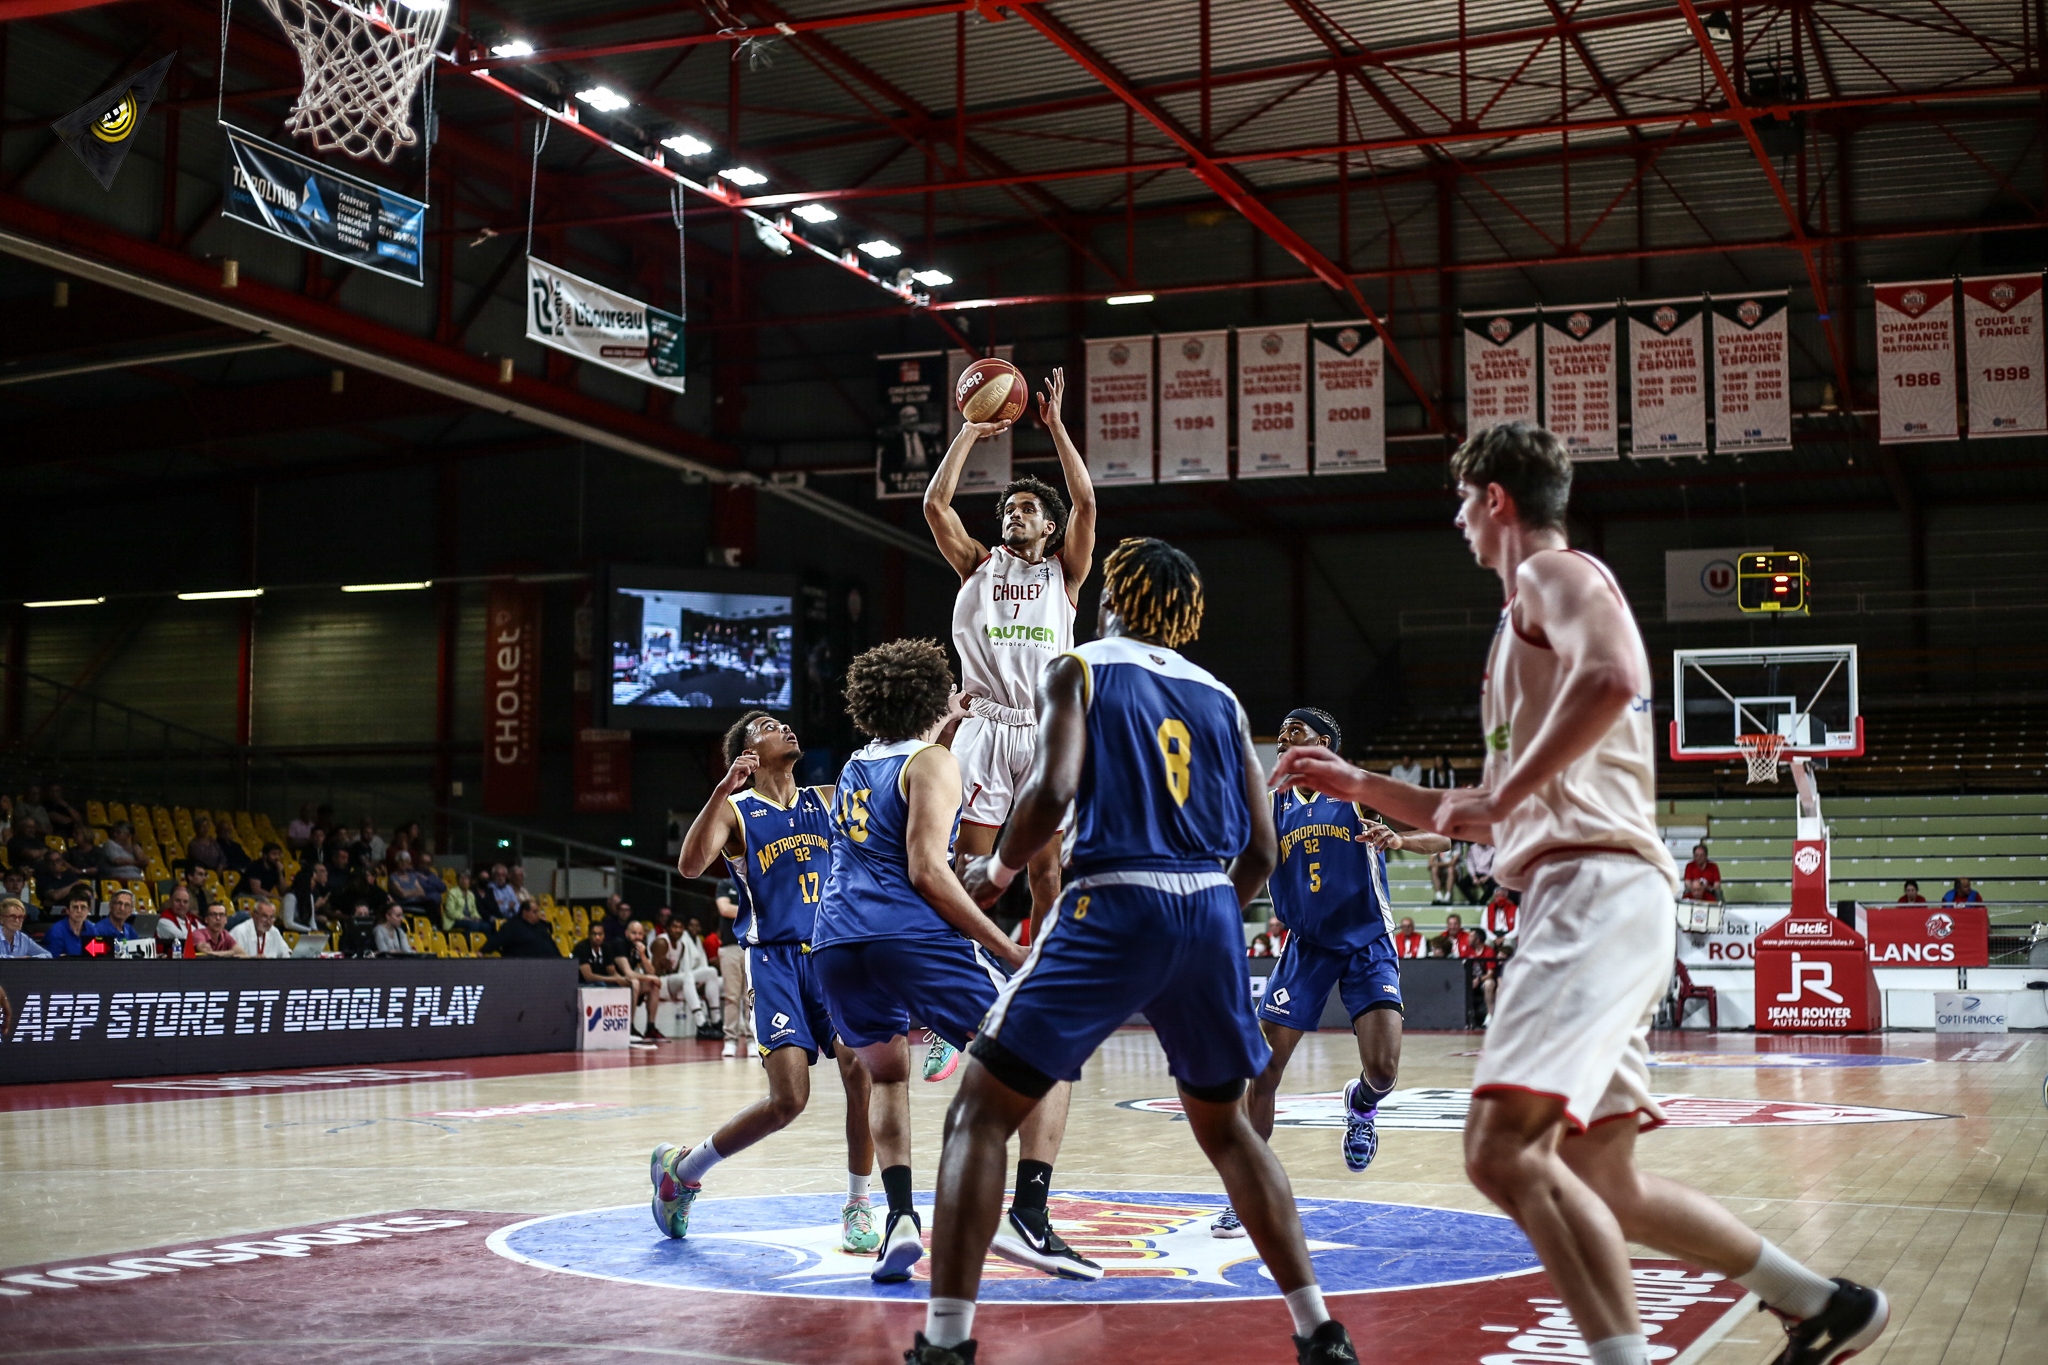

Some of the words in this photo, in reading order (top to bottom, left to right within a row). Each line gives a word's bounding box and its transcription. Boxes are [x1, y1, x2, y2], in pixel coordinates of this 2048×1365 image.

[1882, 321, 1948, 333] CHAMPION
[1975, 316, 2015, 327] COUPE
[2020, 316, 2033, 324] DE
[1718, 332, 1782, 344] CHAMPION
[1898, 332, 1949, 343] FRANCE
[1979, 326, 2030, 338] FRANCE
[1482, 348, 1519, 359] COUPE
[1548, 343, 1611, 354] CHAMPION
[1655, 348, 1694, 358] FUTUR
[1734, 342, 1782, 353] FRANCE
[1882, 344, 1939, 354] NATIONALE
[1485, 358, 1531, 369] FRANCE
[1564, 353, 1611, 363] FRANCE
[1638, 358, 1696, 371] ESPOIRS
[1721, 352, 1781, 366] ESPOIRS
[1243, 363, 1302, 375] CHAMPION
[1475, 370, 1527, 382] CADETS
[1554, 363, 1607, 376] CADETS
[1982, 366, 2030, 382] 1998
[1178, 378, 1222, 388] FRANCE
[1257, 373, 1302, 383] FRANCE
[1325, 378, 1373, 391] CADETS
[1894, 372, 1941, 388] 1986
[958, 371, 983, 402] Jeep
[1243, 383, 1302, 395] MINIMES
[1253, 401, 1294, 416] 1994
[1328, 407, 1371, 422] 2008
[1100, 411, 1139, 426] 1991
[1174, 415, 1214, 430] 1994
[1251, 417, 1294, 432] 2008
[1100, 426, 1140, 441] 1992
[1709, 569, 1729, 589] U
[993, 583, 1041, 601] CHOLET
[1013, 604, 1020, 619] 7
[985, 625, 1054, 643] AUTIER
[1157, 718, 1192, 808] 8
[968, 782, 982, 807] 7
[1280, 824, 1350, 865] METROPOLITANS
[1304, 838, 1320, 854] 92
[757, 834, 829, 875] METROPOLITANS
[794, 847, 811, 862] 92
[1309, 862, 1321, 893] 5
[799, 872, 820, 903] 17
[1074, 896, 1090, 919] 8
[1727, 921, 1749, 935] bat
[1789, 922, 1828, 935] Betclic
[1709, 943, 1755, 960] ROU
[1869, 943, 1955, 961] LANCS
[12, 993, 100, 1043] APP
[106, 991, 229, 1039] STORE
[234, 989, 280, 1034] ET
[284, 987, 407, 1033] GOOGLE
[411, 985, 484, 1028] PLAY
[603, 1005, 628, 1017] INTER
[1768, 1007, 1798, 1020] JEAN
[1802, 1007, 1851, 1019] ROUYER
[603, 1018, 628, 1031] SPORT
[1773, 1018, 1847, 1027] AUTOMOBILES
[1938, 1015, 1960, 1025] OPTI
[1962, 1015, 2004, 1025] FINANCE
[0, 1215, 470, 1297] ransports
